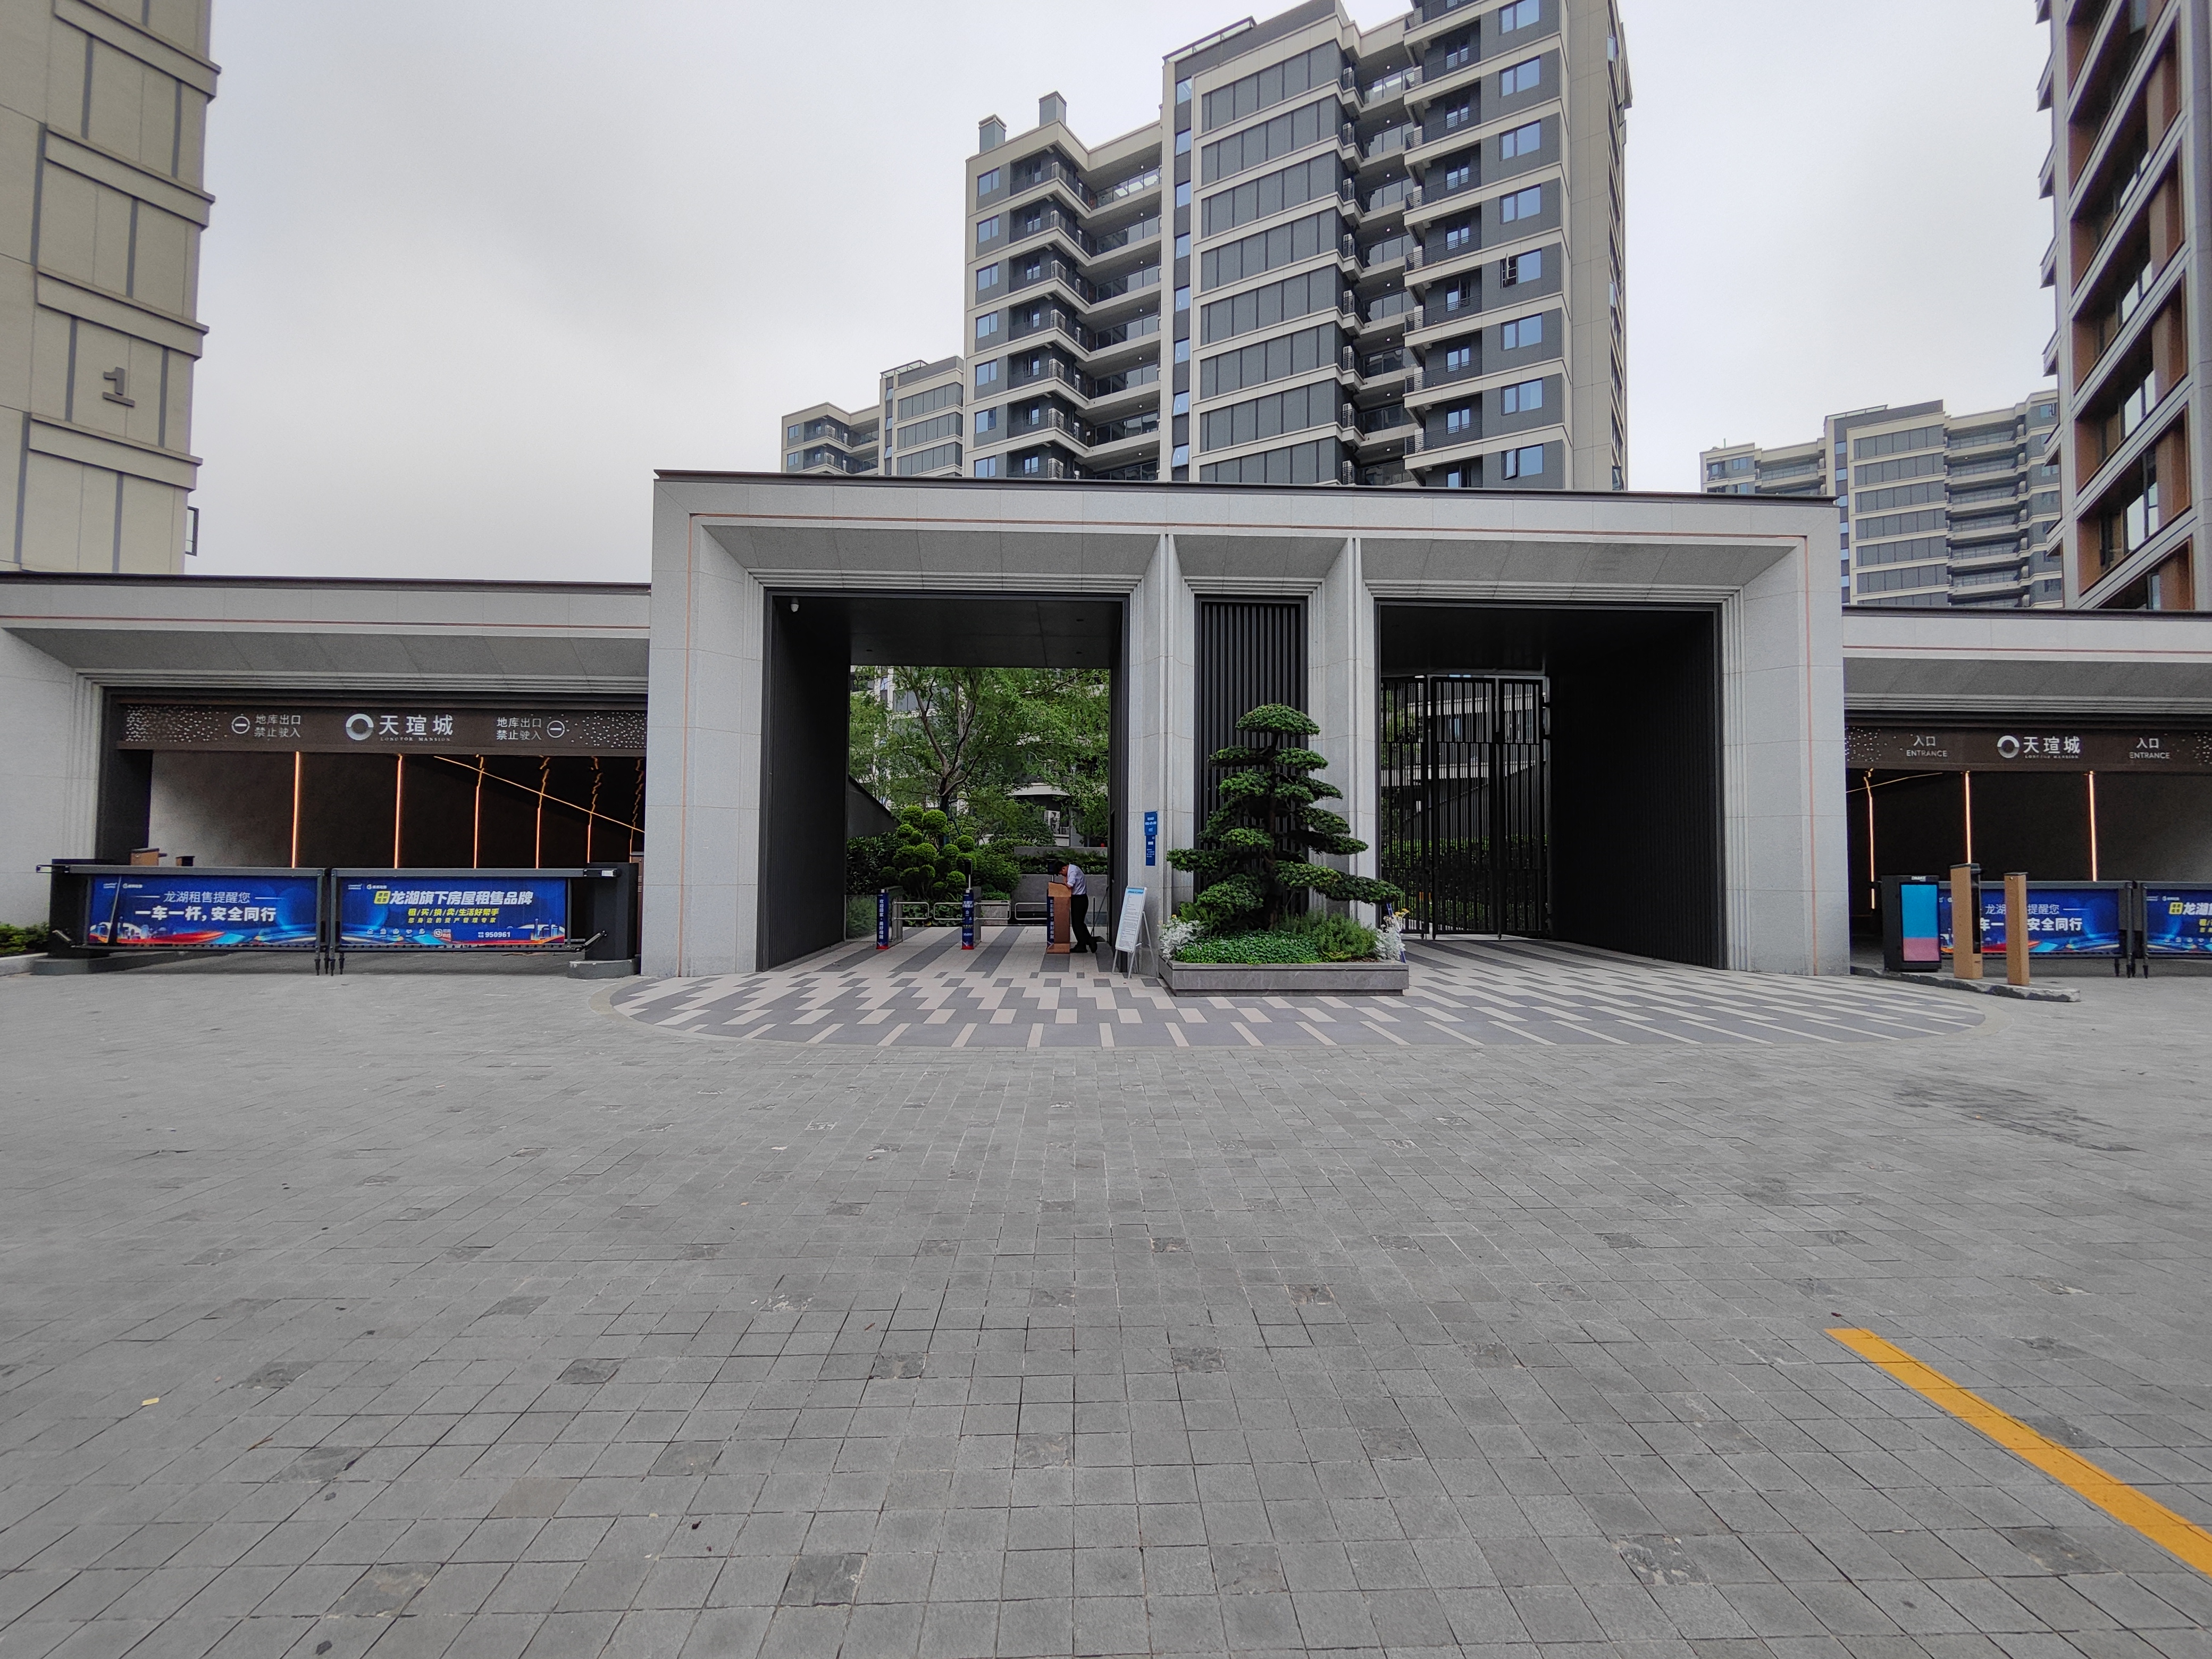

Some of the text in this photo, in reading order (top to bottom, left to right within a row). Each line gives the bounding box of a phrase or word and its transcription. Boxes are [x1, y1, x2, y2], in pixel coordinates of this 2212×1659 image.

[256, 714, 301, 725] 地库出口
[379, 714, 454, 735] 天瑄城
[497, 717, 542, 728] 地库出口
[254, 727, 300, 738] 禁止驶入
[496, 730, 542, 740] 禁止驶入
[1913, 735, 1936, 747] 入口
[2023, 736, 2081, 754] 天瑄城
[2136, 738, 2159, 749] 入口
[163, 891, 250, 903] 龙湖租售提醒您
[389, 891, 533, 904] 龙湖旗下房屋租售品牌
[2182, 902, 2212, 915] 龙湖
